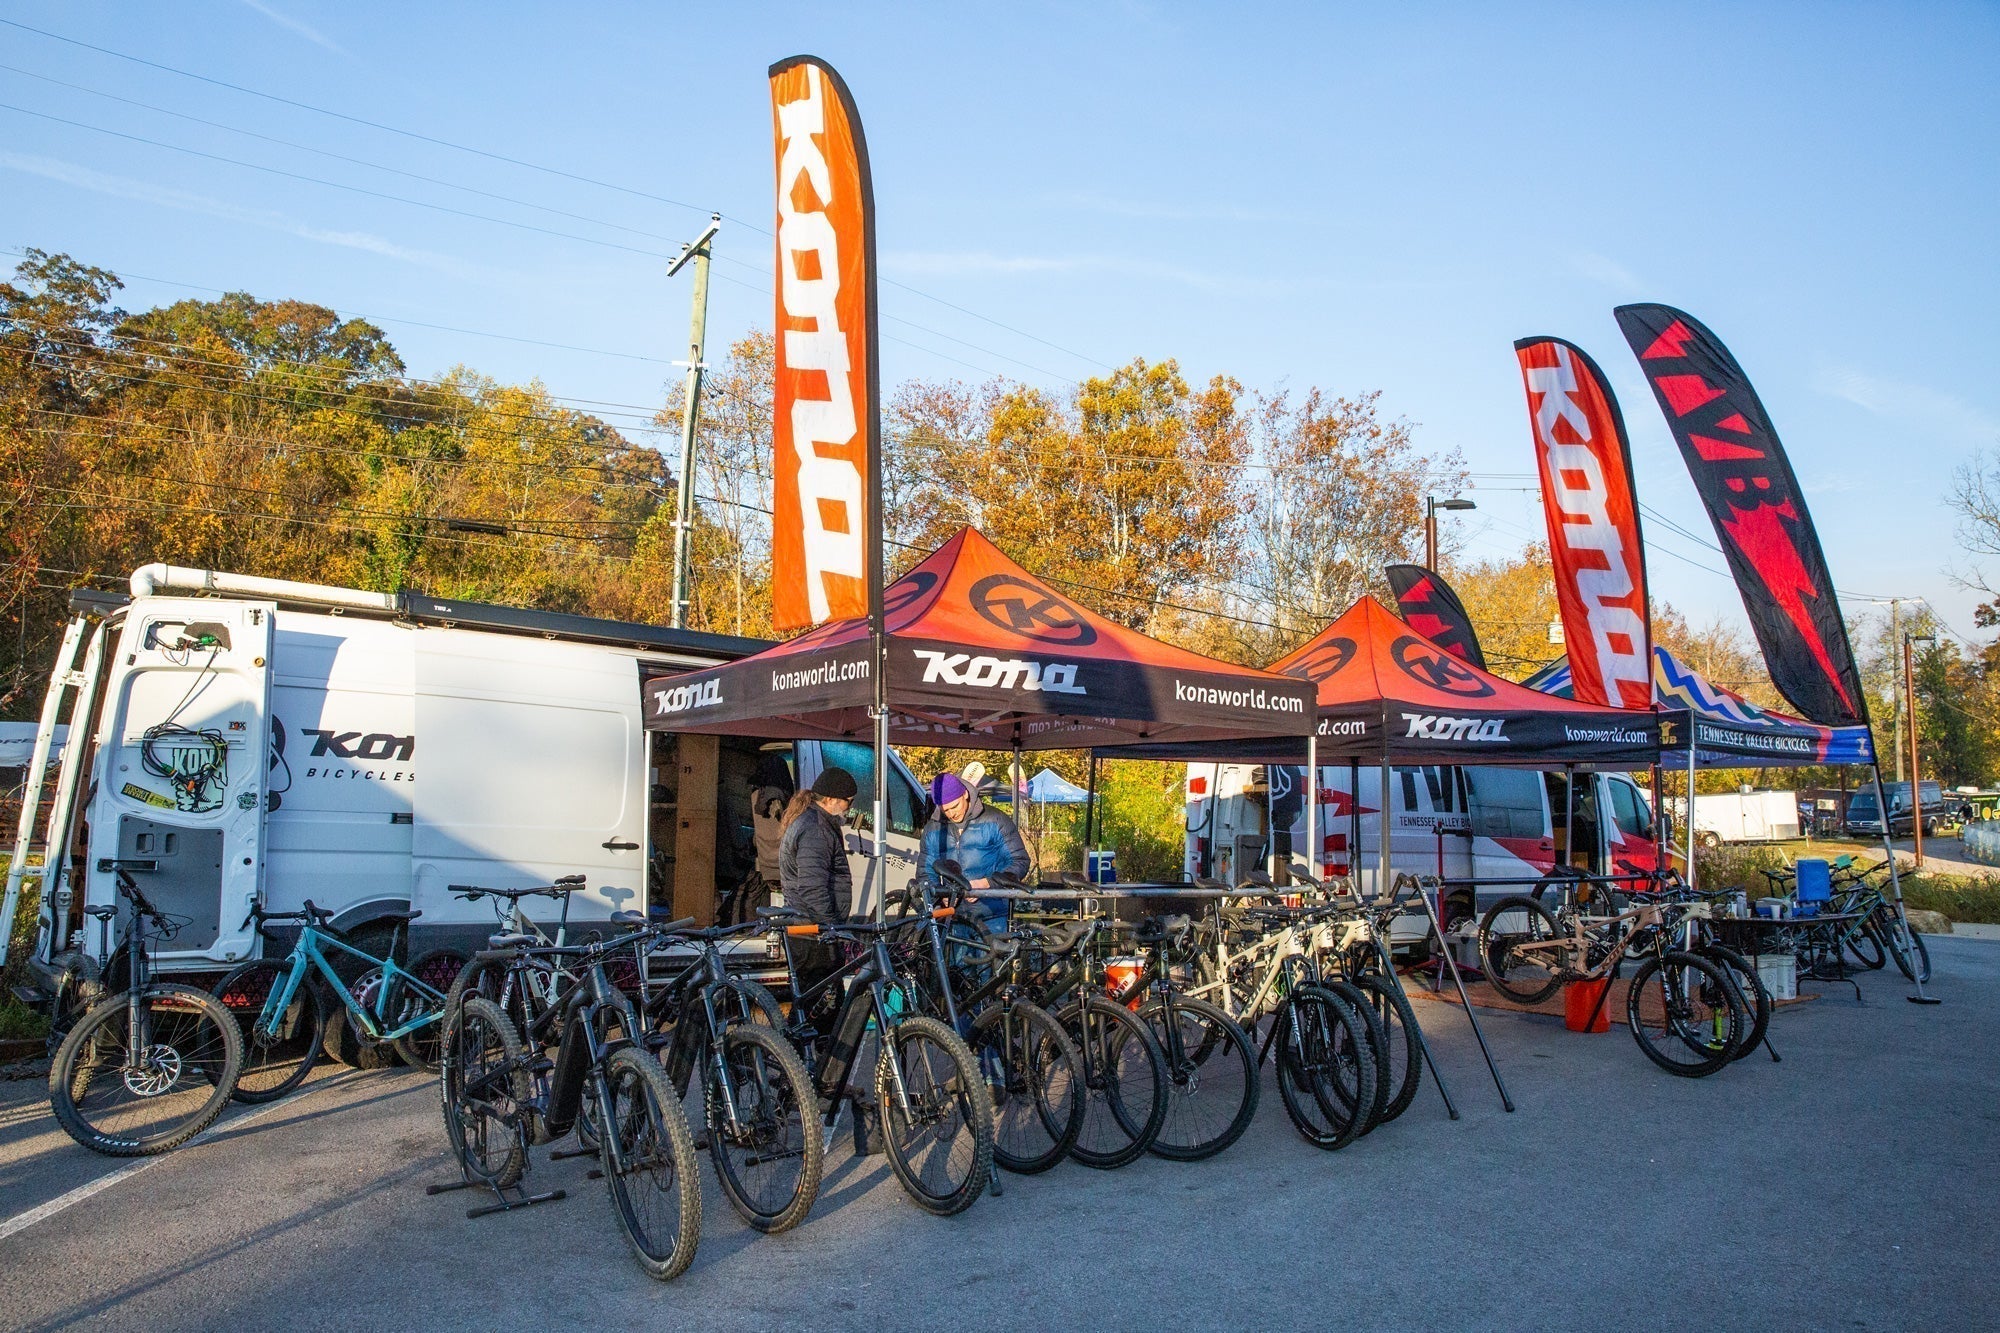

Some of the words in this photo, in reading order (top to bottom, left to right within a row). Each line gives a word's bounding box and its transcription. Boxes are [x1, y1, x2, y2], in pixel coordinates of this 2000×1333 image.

[772, 660, 869, 691] konaworld.com
[1175, 680, 1303, 712] konaworld.com
[1565, 725, 1647, 743] konaworld.com
[1698, 725, 1744, 746] TENNESSEE
[1745, 733, 1774, 749] VALLEY
[1775, 736, 1810, 752] BICYCLES
[1400, 817, 1435, 827] TENNESSEE
